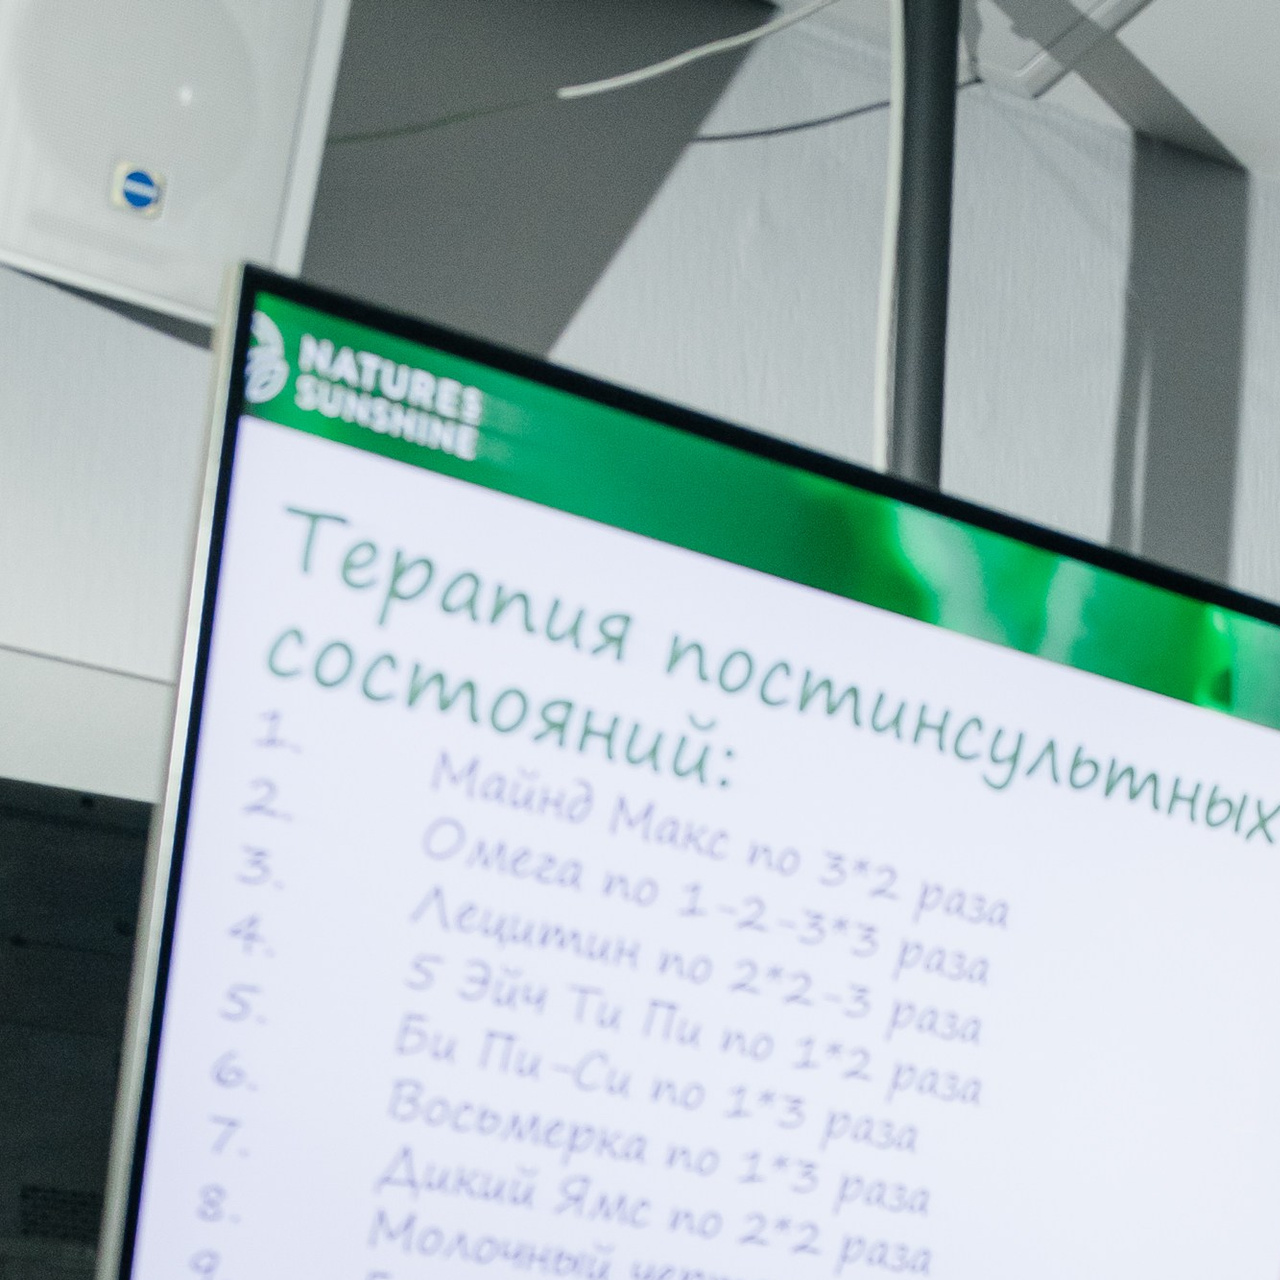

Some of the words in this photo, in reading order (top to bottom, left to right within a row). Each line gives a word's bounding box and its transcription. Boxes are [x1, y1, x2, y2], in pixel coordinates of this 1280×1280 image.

[294, 374, 480, 461] SUNSHINE
[298, 333, 482, 425] NATURES
[285, 506, 633, 663] Терапия
[267, 628, 735, 789] состояний:
[241, 777, 295, 824] 2.
[421, 815, 584, 892] Омега
[601, 871, 660, 908] по
[891, 936, 991, 986] раза
[255, 709, 304, 755] 1.
[430, 748, 596, 825] Майнд
[608, 792, 731, 862] Макс
[746, 841, 801, 878] по
[911, 878, 1011, 931] раза
[225, 912, 278, 959] 4.
[457, 957, 550, 1015] Эйч
[569, 981, 622, 1033] Ти
[642, 996, 704, 1050] Пи
[719, 1025, 775, 1063] по
[884, 1058, 983, 1108] раза
[236, 843, 287, 892] 3.
[409, 882, 642, 972] Лецитин
[657, 947, 714, 986] по
[882, 997, 983, 1047] раза
[209, 1049, 260, 1092] 6.
[387, 1077, 648, 1167] Восьмерка
[664, 1142, 721, 1178] по
[831, 1172, 933, 1218] раза
[219, 982, 268, 1026] 5.
[393, 1010, 458, 1065] Би
[649, 1076, 707, 1112] по
[818, 1109, 920, 1155] раза
[195, 1180, 242, 1225] 8.
[206, 1113, 252, 1159] 7.
[372, 1144, 541, 1209] Дикий
[554, 1173, 653, 1230] Ямс
[667, 1205, 724, 1241] по
[832, 1233, 934, 1278] раза
